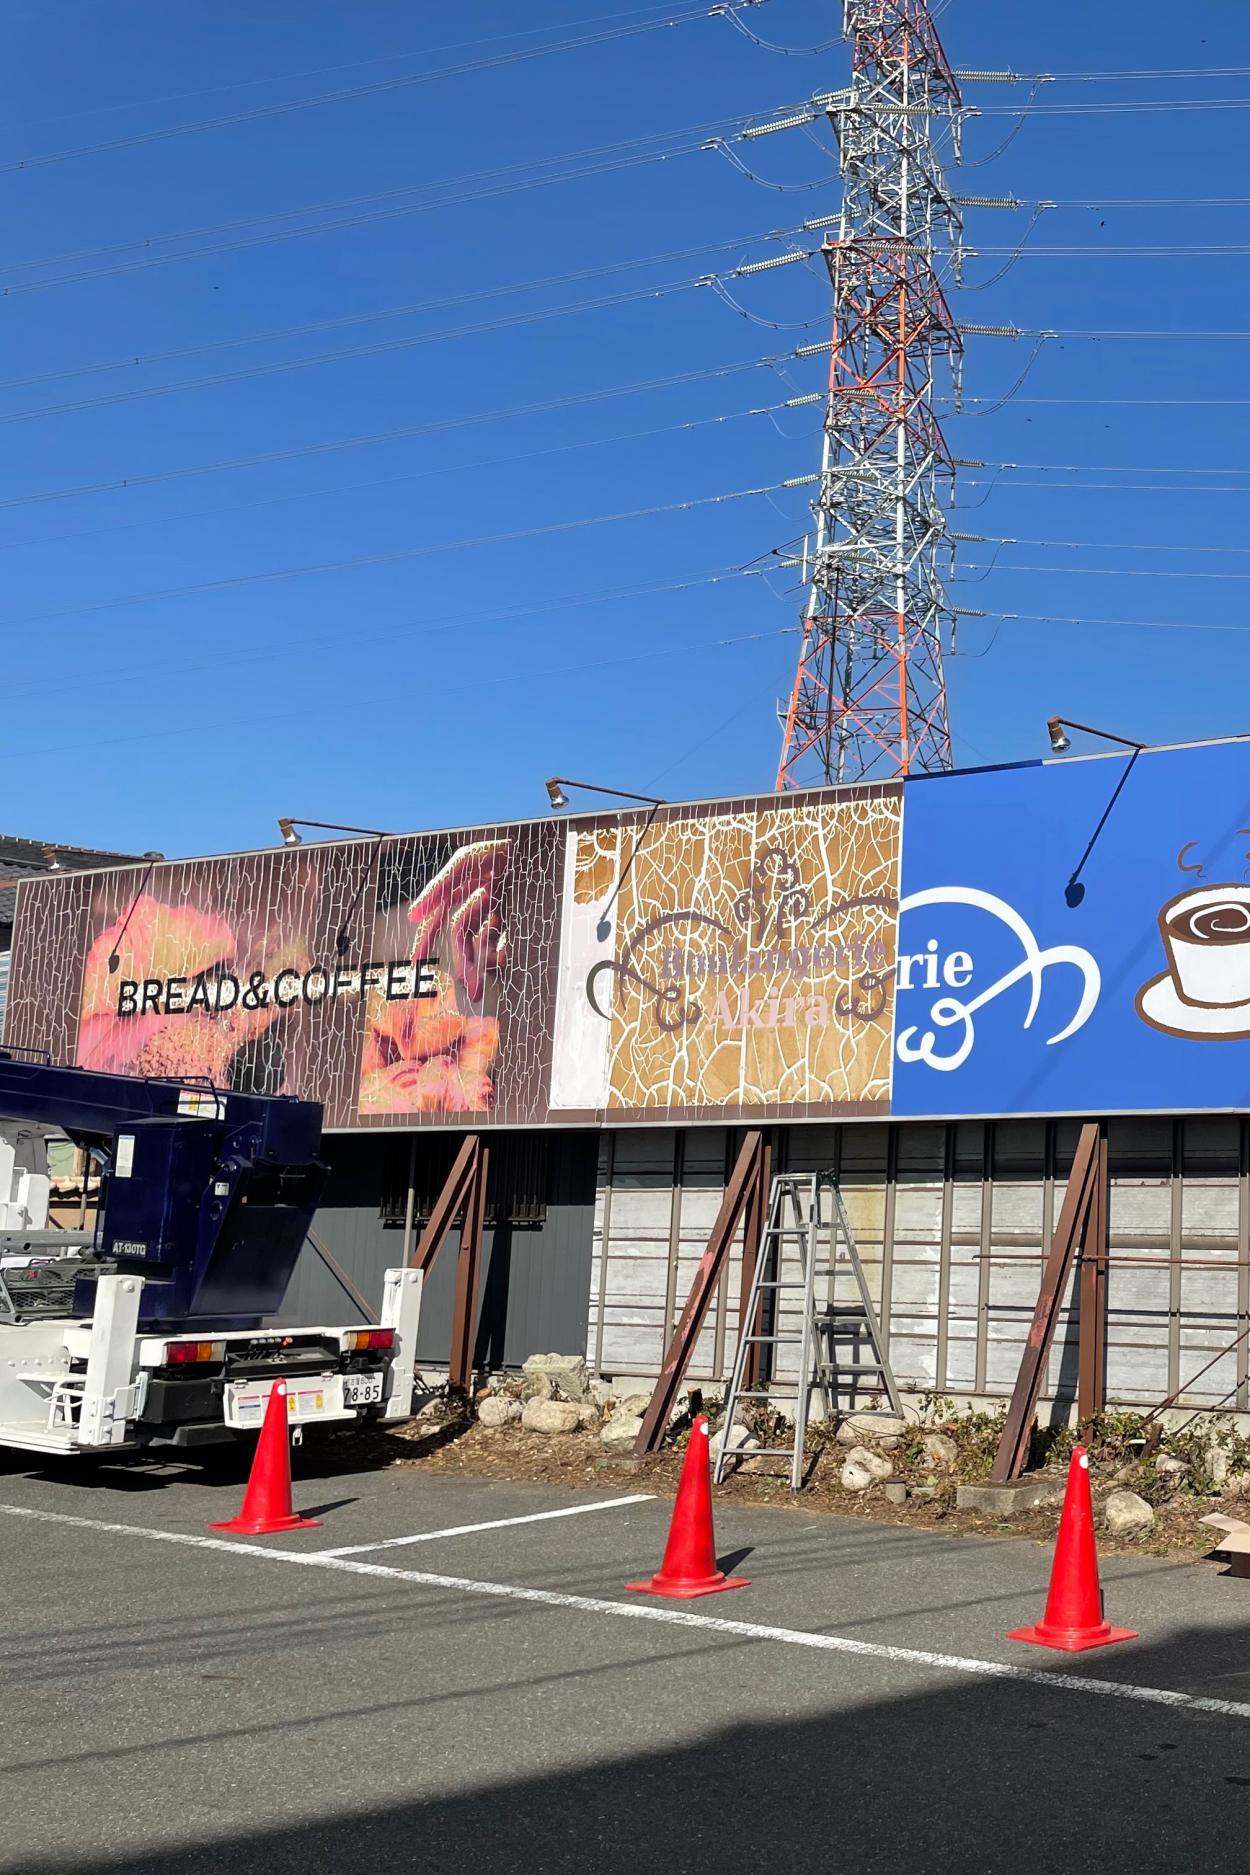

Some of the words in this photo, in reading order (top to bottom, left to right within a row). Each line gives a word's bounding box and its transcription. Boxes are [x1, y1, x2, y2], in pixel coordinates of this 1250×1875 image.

[117, 957, 440, 1017] BREAD&COFFEE
[704, 986, 829, 1030] Akira
[344, 1385, 380, 1402] 78-85
